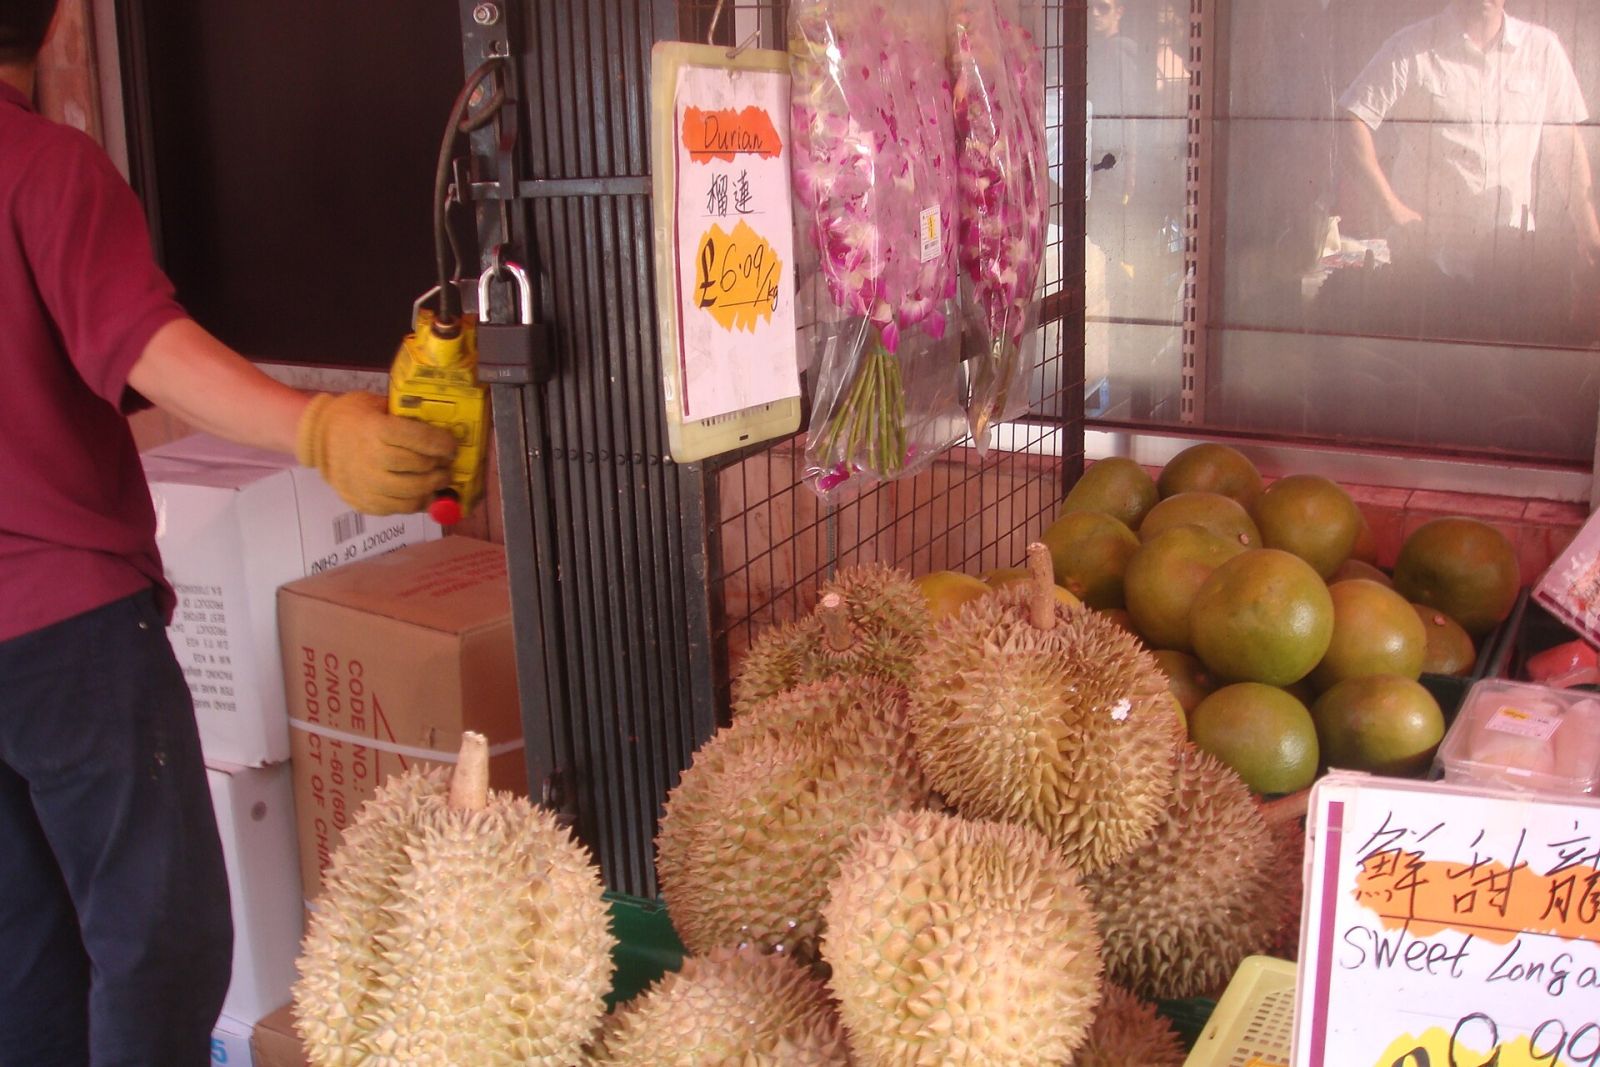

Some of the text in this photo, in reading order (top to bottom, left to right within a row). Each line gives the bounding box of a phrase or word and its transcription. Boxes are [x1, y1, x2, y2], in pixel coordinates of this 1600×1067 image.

[704, 115, 763, 150] Durian
[362, 522, 406, 553] PRODUCT
[348, 659, 367, 732] CODE
[311, 775, 325, 807] OF
[314, 817, 332, 887] CHIN
